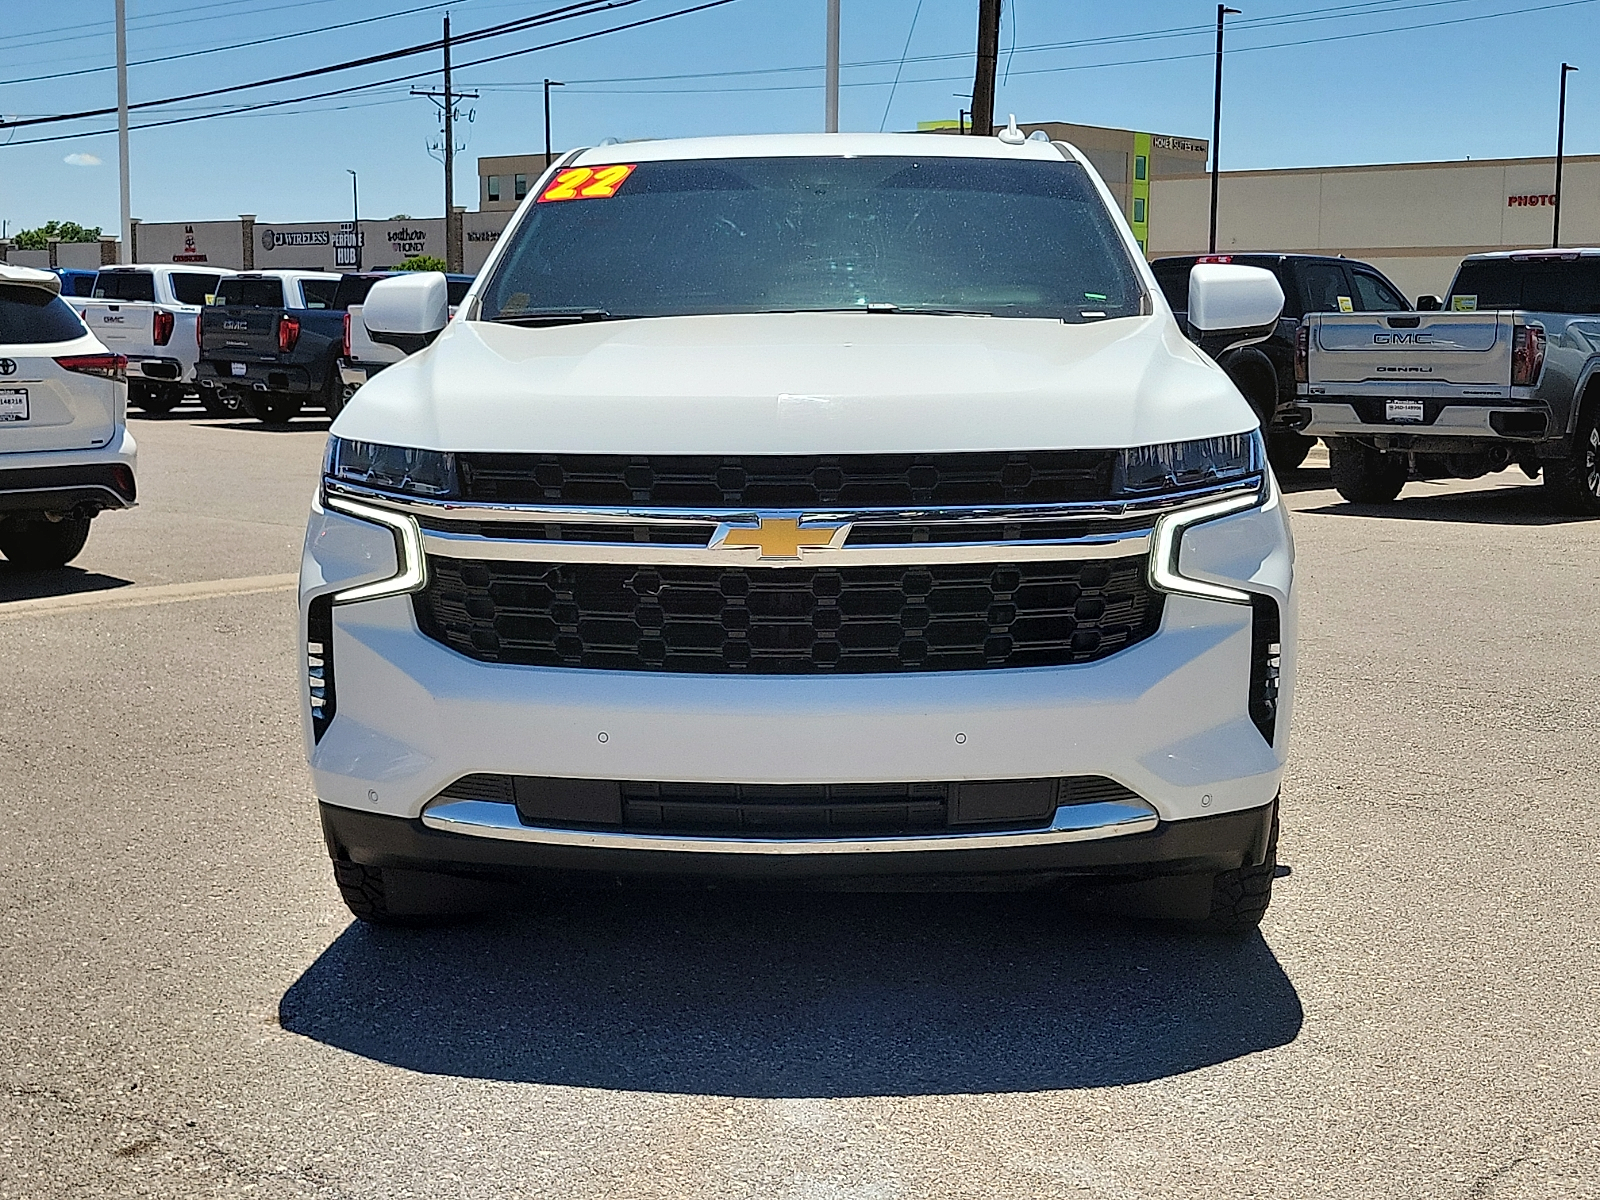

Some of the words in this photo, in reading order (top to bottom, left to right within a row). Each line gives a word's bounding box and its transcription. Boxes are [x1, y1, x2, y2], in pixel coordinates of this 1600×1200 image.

[544, 165, 631, 200] 22
[274, 233, 283, 245] CJ
[285, 231, 329, 245] WIRELESS
[331, 232, 364, 247] PERFUME
[398, 242, 426, 252] HONEY
[337, 247, 358, 264] HUB
[104, 316, 125, 324] GMC
[223, 320, 248, 330] GMC
[1373, 333, 1435, 345] GMC
